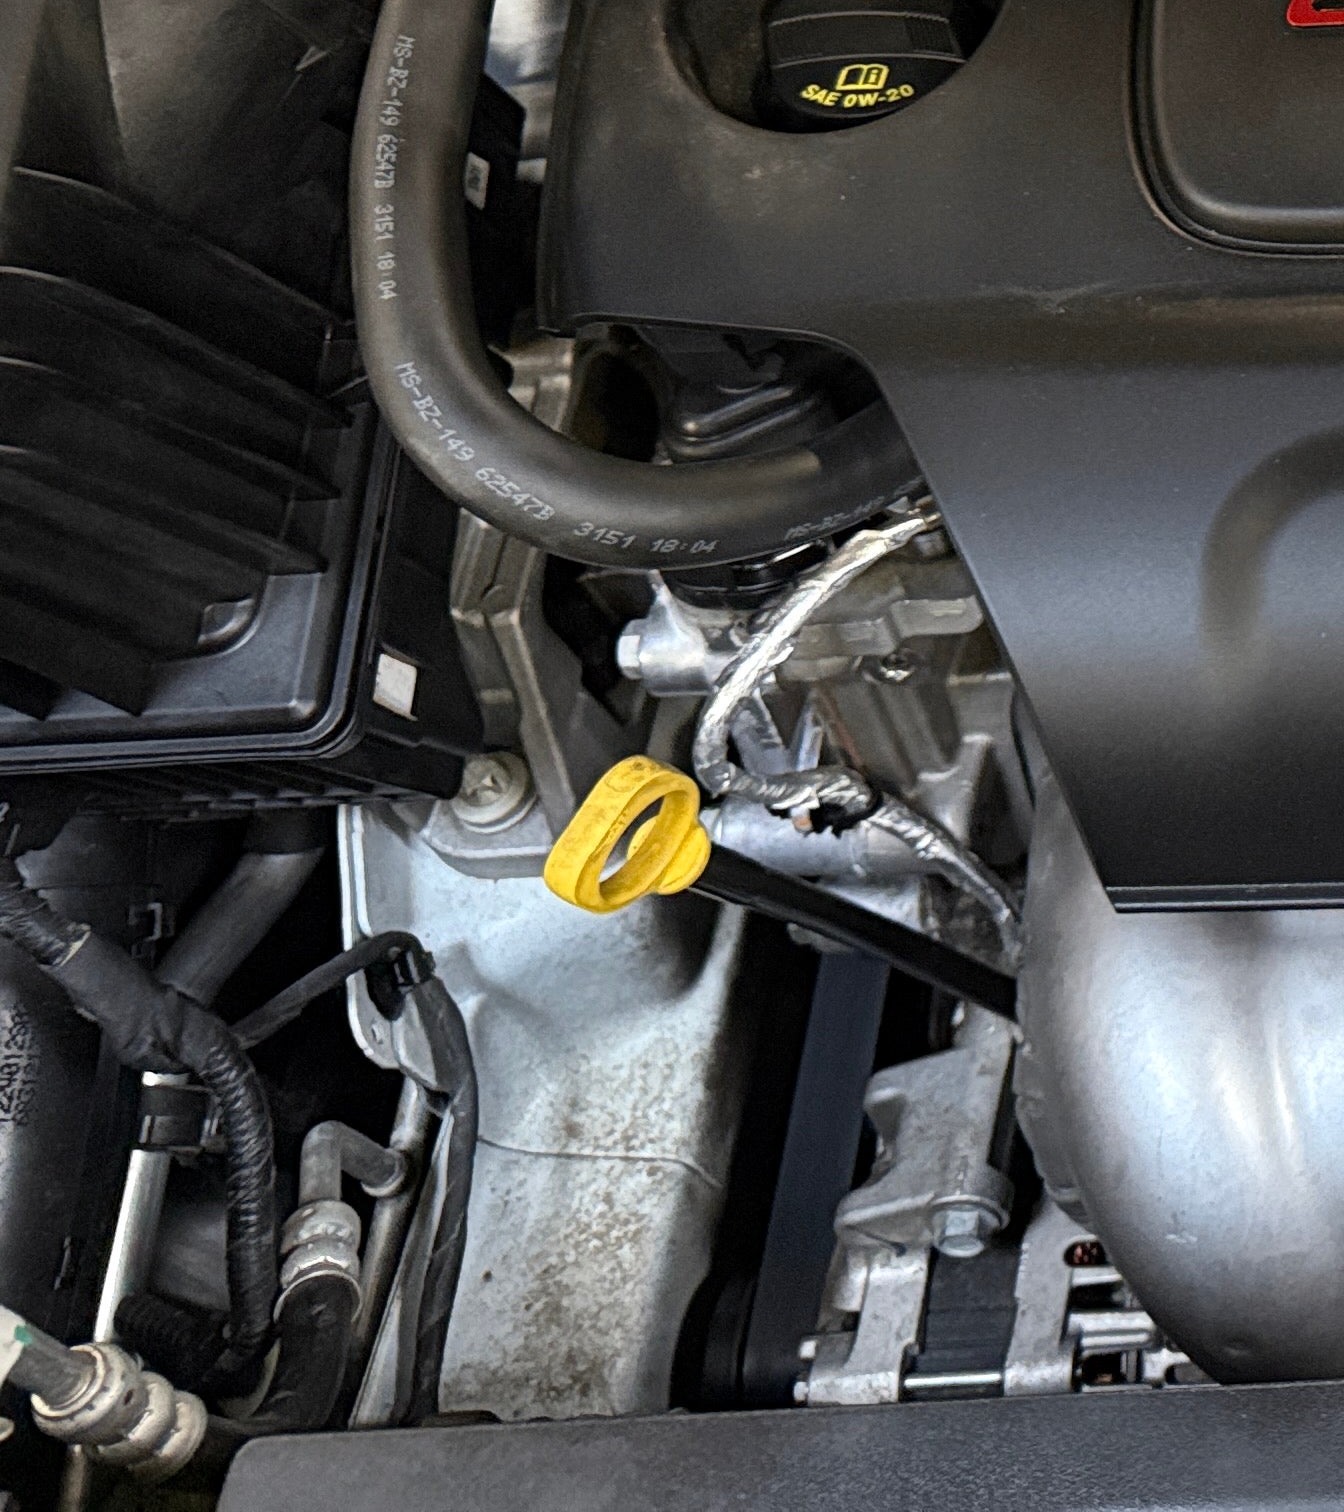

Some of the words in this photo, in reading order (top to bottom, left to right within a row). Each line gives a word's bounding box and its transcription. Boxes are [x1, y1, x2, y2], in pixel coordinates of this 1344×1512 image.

[379, 33, 417, 128] MS-BZ-149
[800, 83, 840, 107] SAE
[843, 84, 915, 109] 0W-20
[372, 133, 400, 189] 62547B
[373, 203, 394, 242] 3151
[398, 361, 475, 462] MS-BZ-149
[474, 465, 556, 521] 62547B
[574, 520, 636, 549] 3151
[650, 538, 720, 556] 18:04
